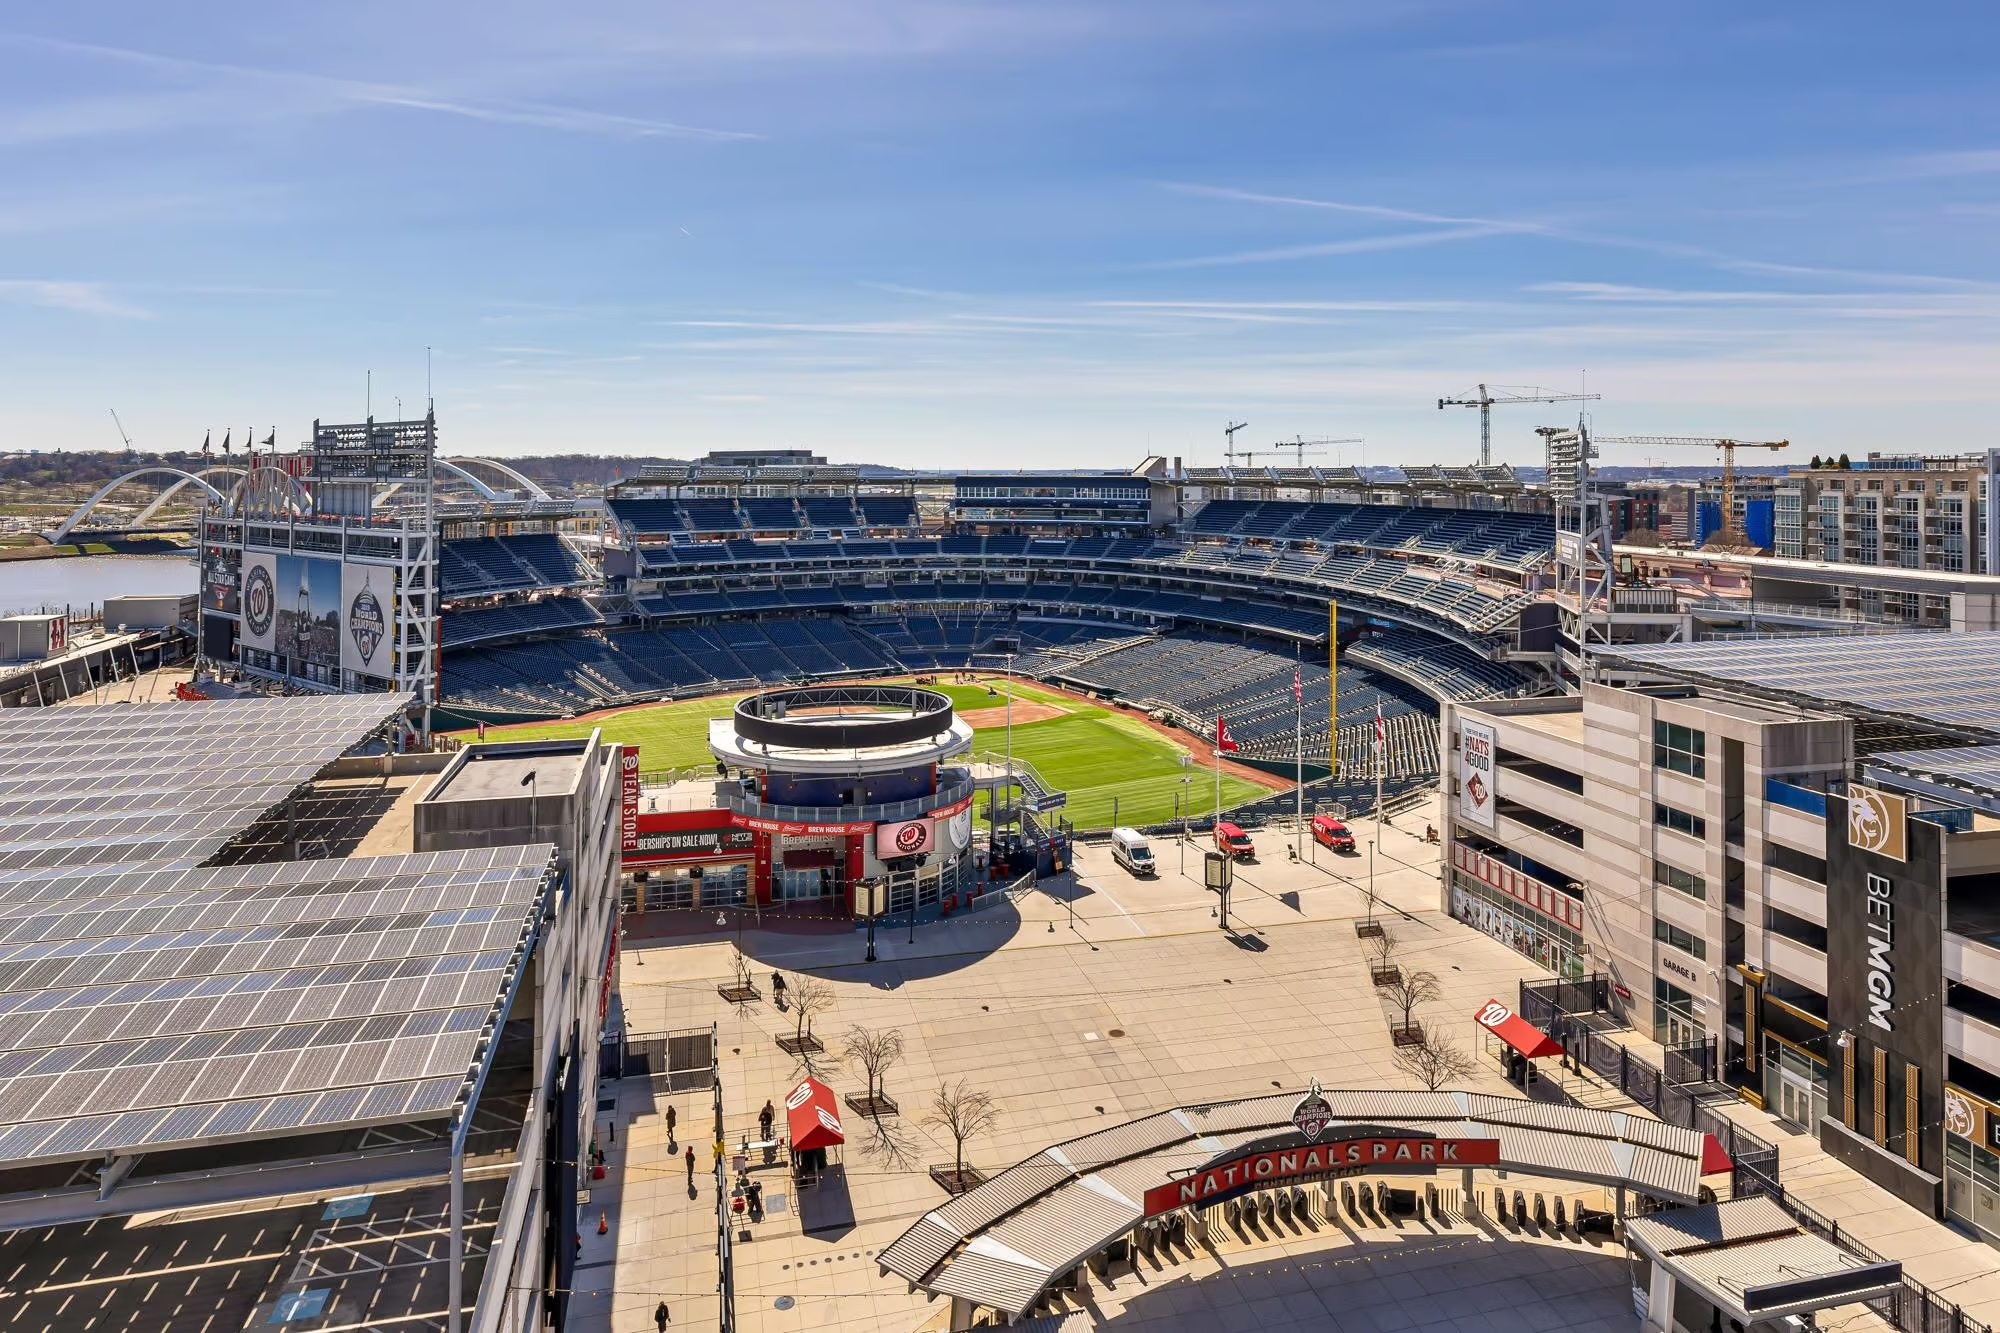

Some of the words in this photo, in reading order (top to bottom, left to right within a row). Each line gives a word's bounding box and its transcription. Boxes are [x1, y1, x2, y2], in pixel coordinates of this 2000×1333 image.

[355, 608, 378, 620] WORLD
[351, 618, 383, 635] CHAMPIONS
[1465, 735, 1489, 757] #NATS
[1465, 750, 1489, 771] 4GOOD
[623, 773, 637, 805] TEAM
[623, 808, 637, 848] STORE
[749, 820, 762, 828] BREW
[762, 821, 779, 831] HOUSE
[682, 835, 699, 848] SALE
[898, 835, 925, 851] NATIONALS
[1867, 872, 1893, 1032] BETMGM
[1663, 958, 1690, 979] GARAGE
[1691, 972, 1697, 982] B
[1295, 1111, 1331, 1122] CHAMPIONS
[1300, 1106, 1325, 1115] WORLD
[1179, 1144, 1360, 1201] NATIONALS
[1373, 1142, 1459, 1161] PARK
